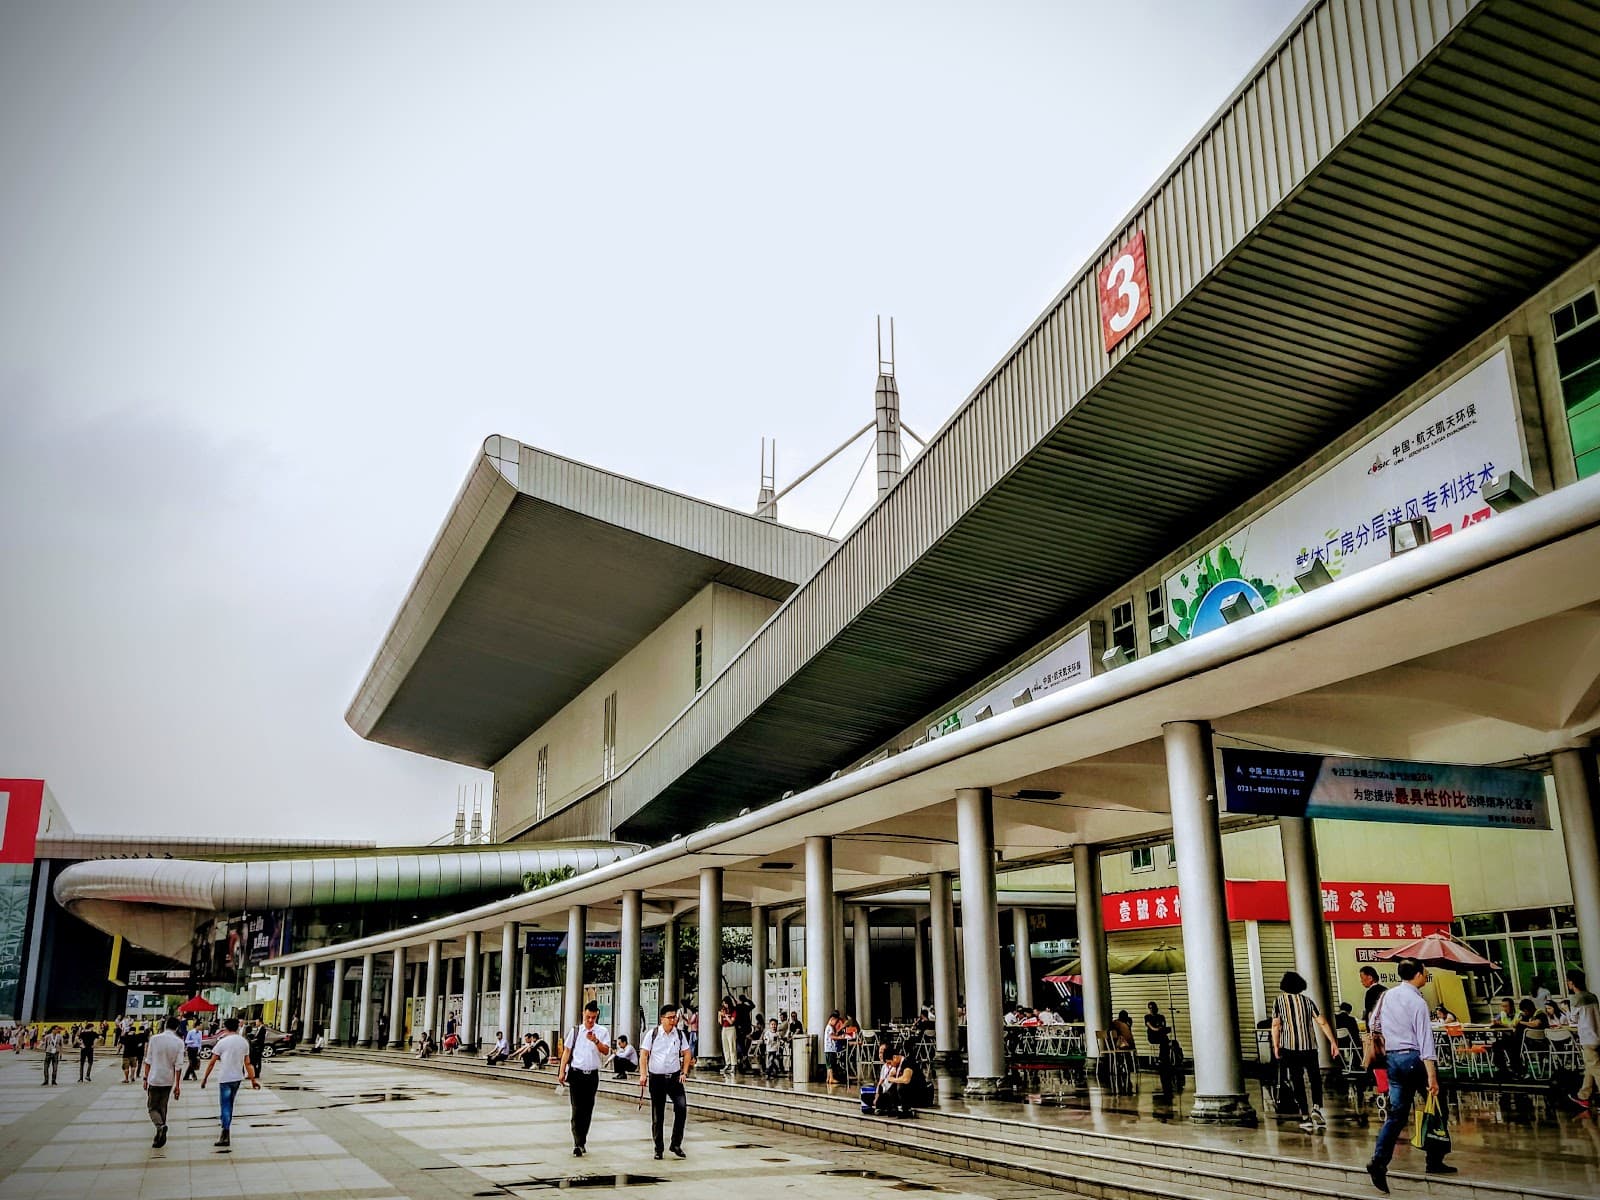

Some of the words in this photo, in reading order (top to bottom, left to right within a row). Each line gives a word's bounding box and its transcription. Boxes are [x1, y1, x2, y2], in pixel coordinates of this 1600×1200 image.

[1106, 254, 1140, 332] 3
[1392, 403, 1477, 457] 中国·航天凯天环保
